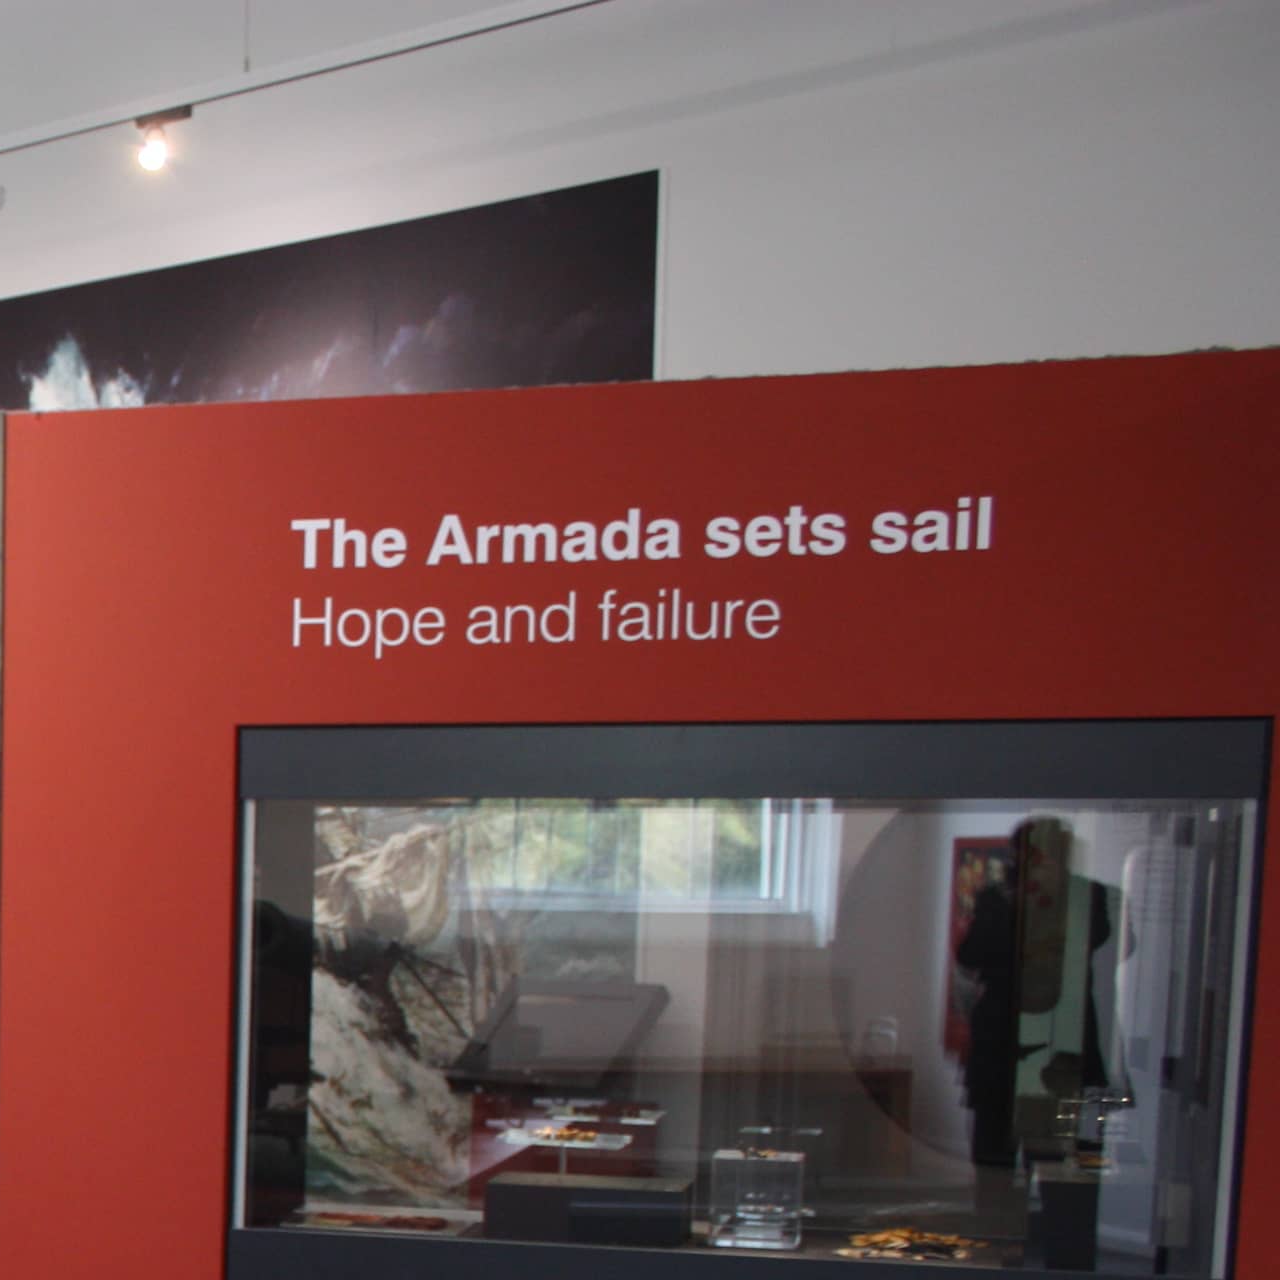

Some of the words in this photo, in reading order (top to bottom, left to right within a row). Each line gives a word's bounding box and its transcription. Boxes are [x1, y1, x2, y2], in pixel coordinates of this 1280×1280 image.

[291, 517, 408, 569] The
[426, 508, 681, 566] Armada
[703, 504, 847, 559] sets
[869, 497, 994, 554] sail
[291, 596, 446, 660] Hope
[465, 591, 578, 645] and
[597, 588, 781, 642] failure
